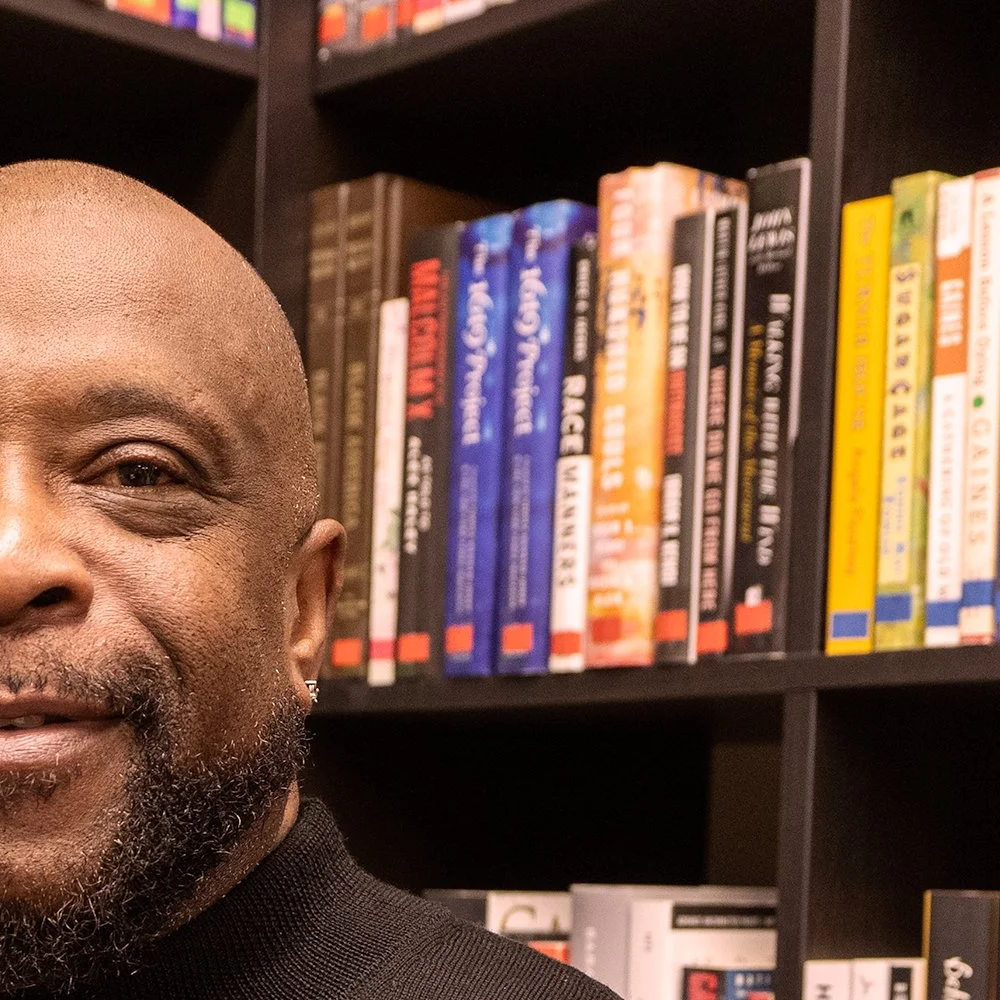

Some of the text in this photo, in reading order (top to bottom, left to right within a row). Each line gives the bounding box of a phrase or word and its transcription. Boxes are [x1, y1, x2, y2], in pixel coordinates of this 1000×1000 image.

[405, 257, 441, 396] MALCOLM
[605, 269, 632, 394] HUNDRED
[764, 293, 792, 394] WALKING
[938, 278, 965, 350] GAINES
[459, 349, 489, 446] Project
[511, 337, 542, 438] Project
[762, 396, 781, 454] WITH
[557, 374, 588, 589] RACE MANNERS
[600, 403, 626, 492] SOULS
[699, 366, 727, 612] WHERE DO WE GO FROM HERE
[759, 458, 779, 499] THE
[967, 418, 991, 546] GAINES
[756, 504, 782, 567] WIND
